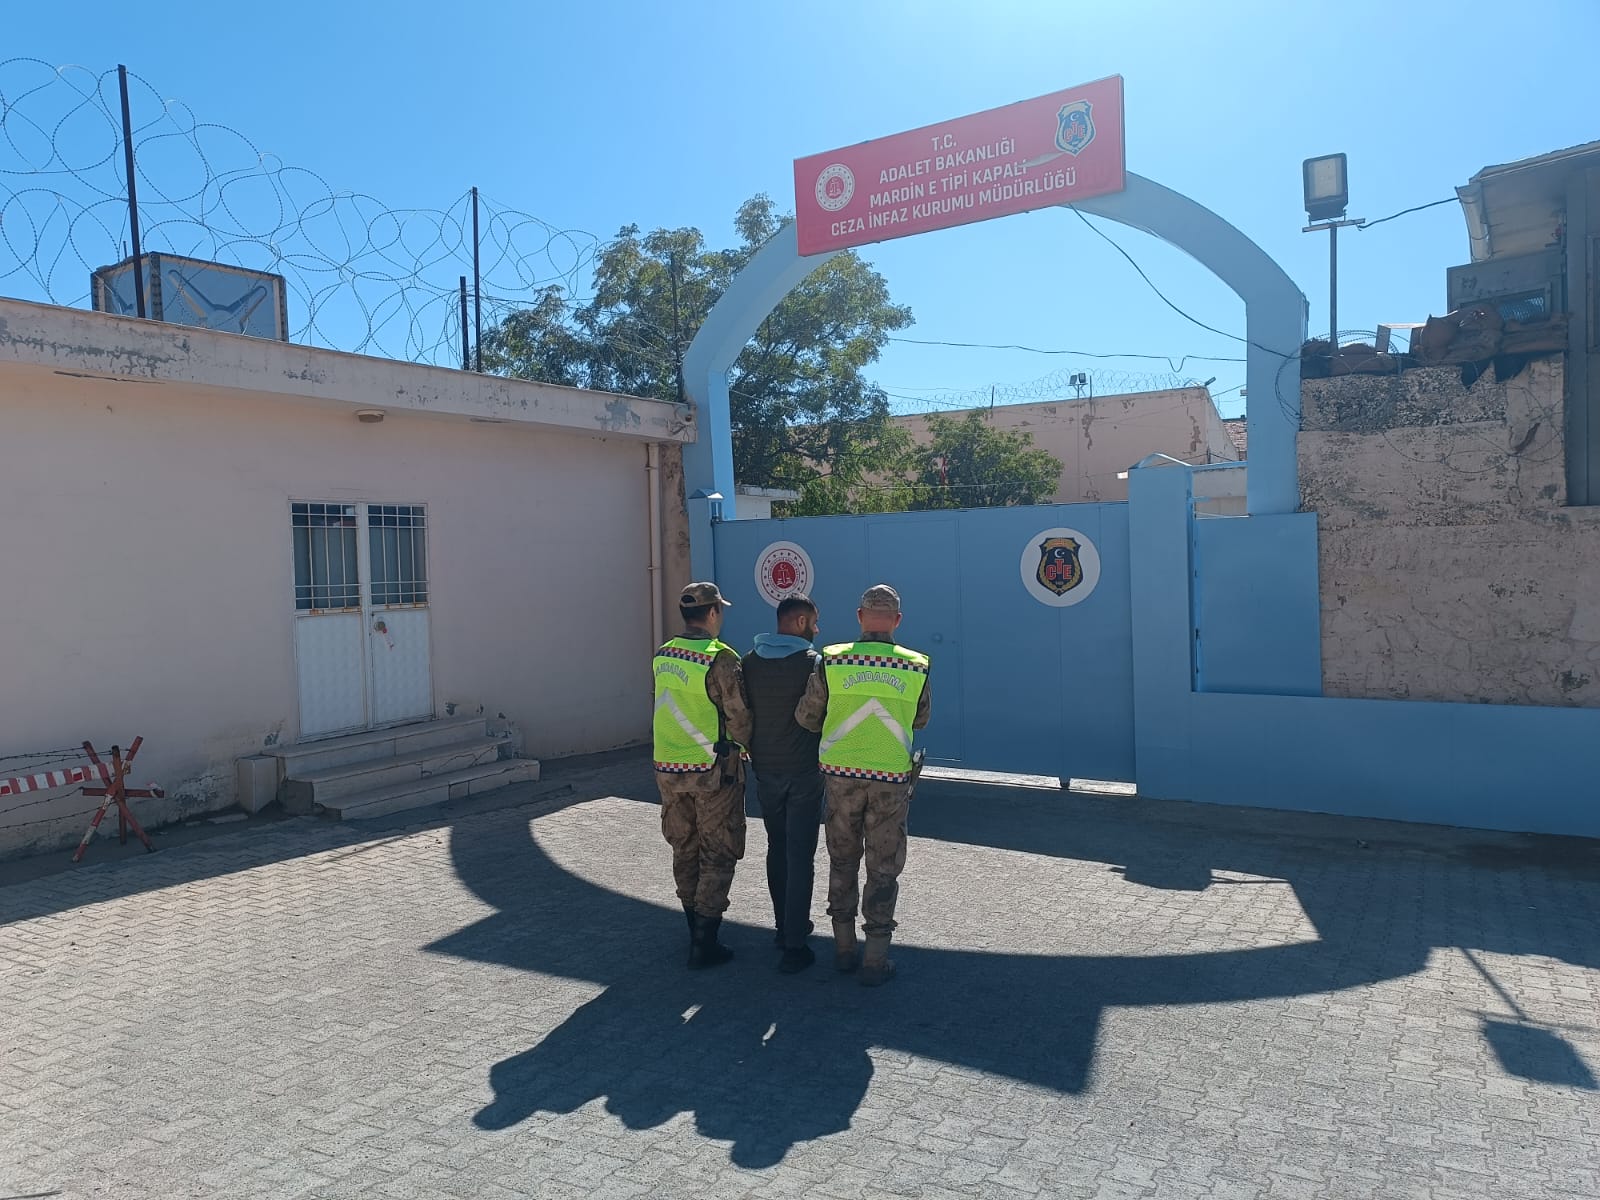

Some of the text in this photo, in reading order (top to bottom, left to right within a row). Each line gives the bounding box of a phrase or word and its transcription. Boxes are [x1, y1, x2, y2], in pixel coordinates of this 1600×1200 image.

[932, 133, 957, 152] T.C.
[879, 136, 1015, 184] ADALET BAKANLIĞI
[831, 167, 1076, 237] CEZA İNFAZ KURUMU MÜDÜRLÜĞÜ
[869, 180, 925, 208] MARDİN
[928, 179, 937, 195] E
[940, 173, 968, 191] TİPİ
[1045, 558, 1072, 580] CTE
[843, 670, 907, 693] JANDARMA
